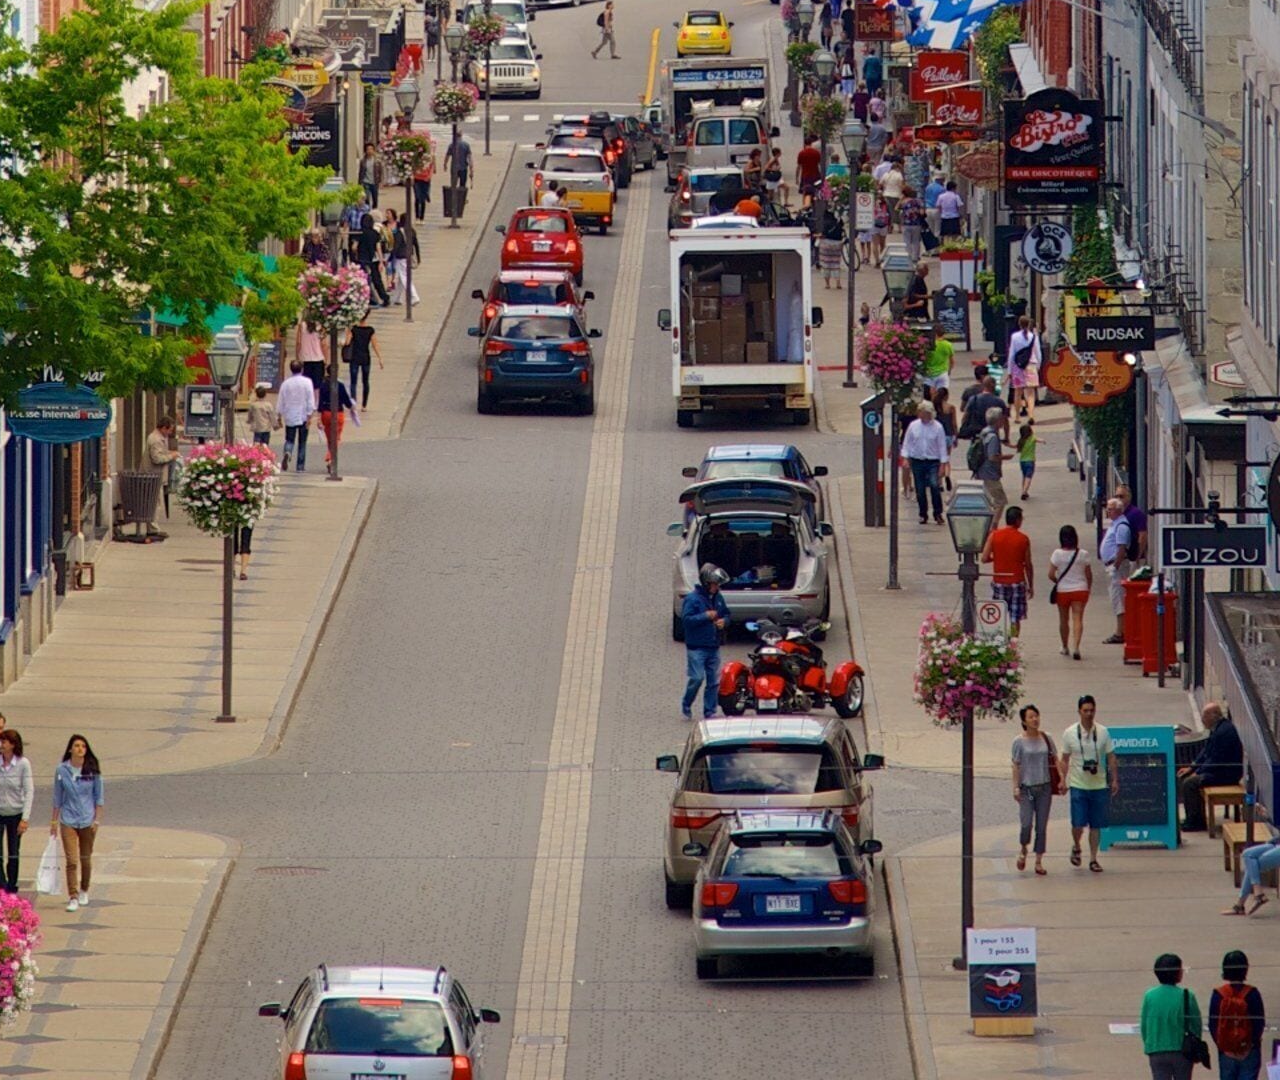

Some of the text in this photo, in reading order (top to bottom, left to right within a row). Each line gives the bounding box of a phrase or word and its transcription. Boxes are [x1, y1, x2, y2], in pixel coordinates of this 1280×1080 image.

[706, 69, 763, 81] 623-0829
[1010, 113, 1083, 148] Bistro
[1086, 328, 1144, 340] RUDSAK
[1170, 530, 1258, 563] bizou
